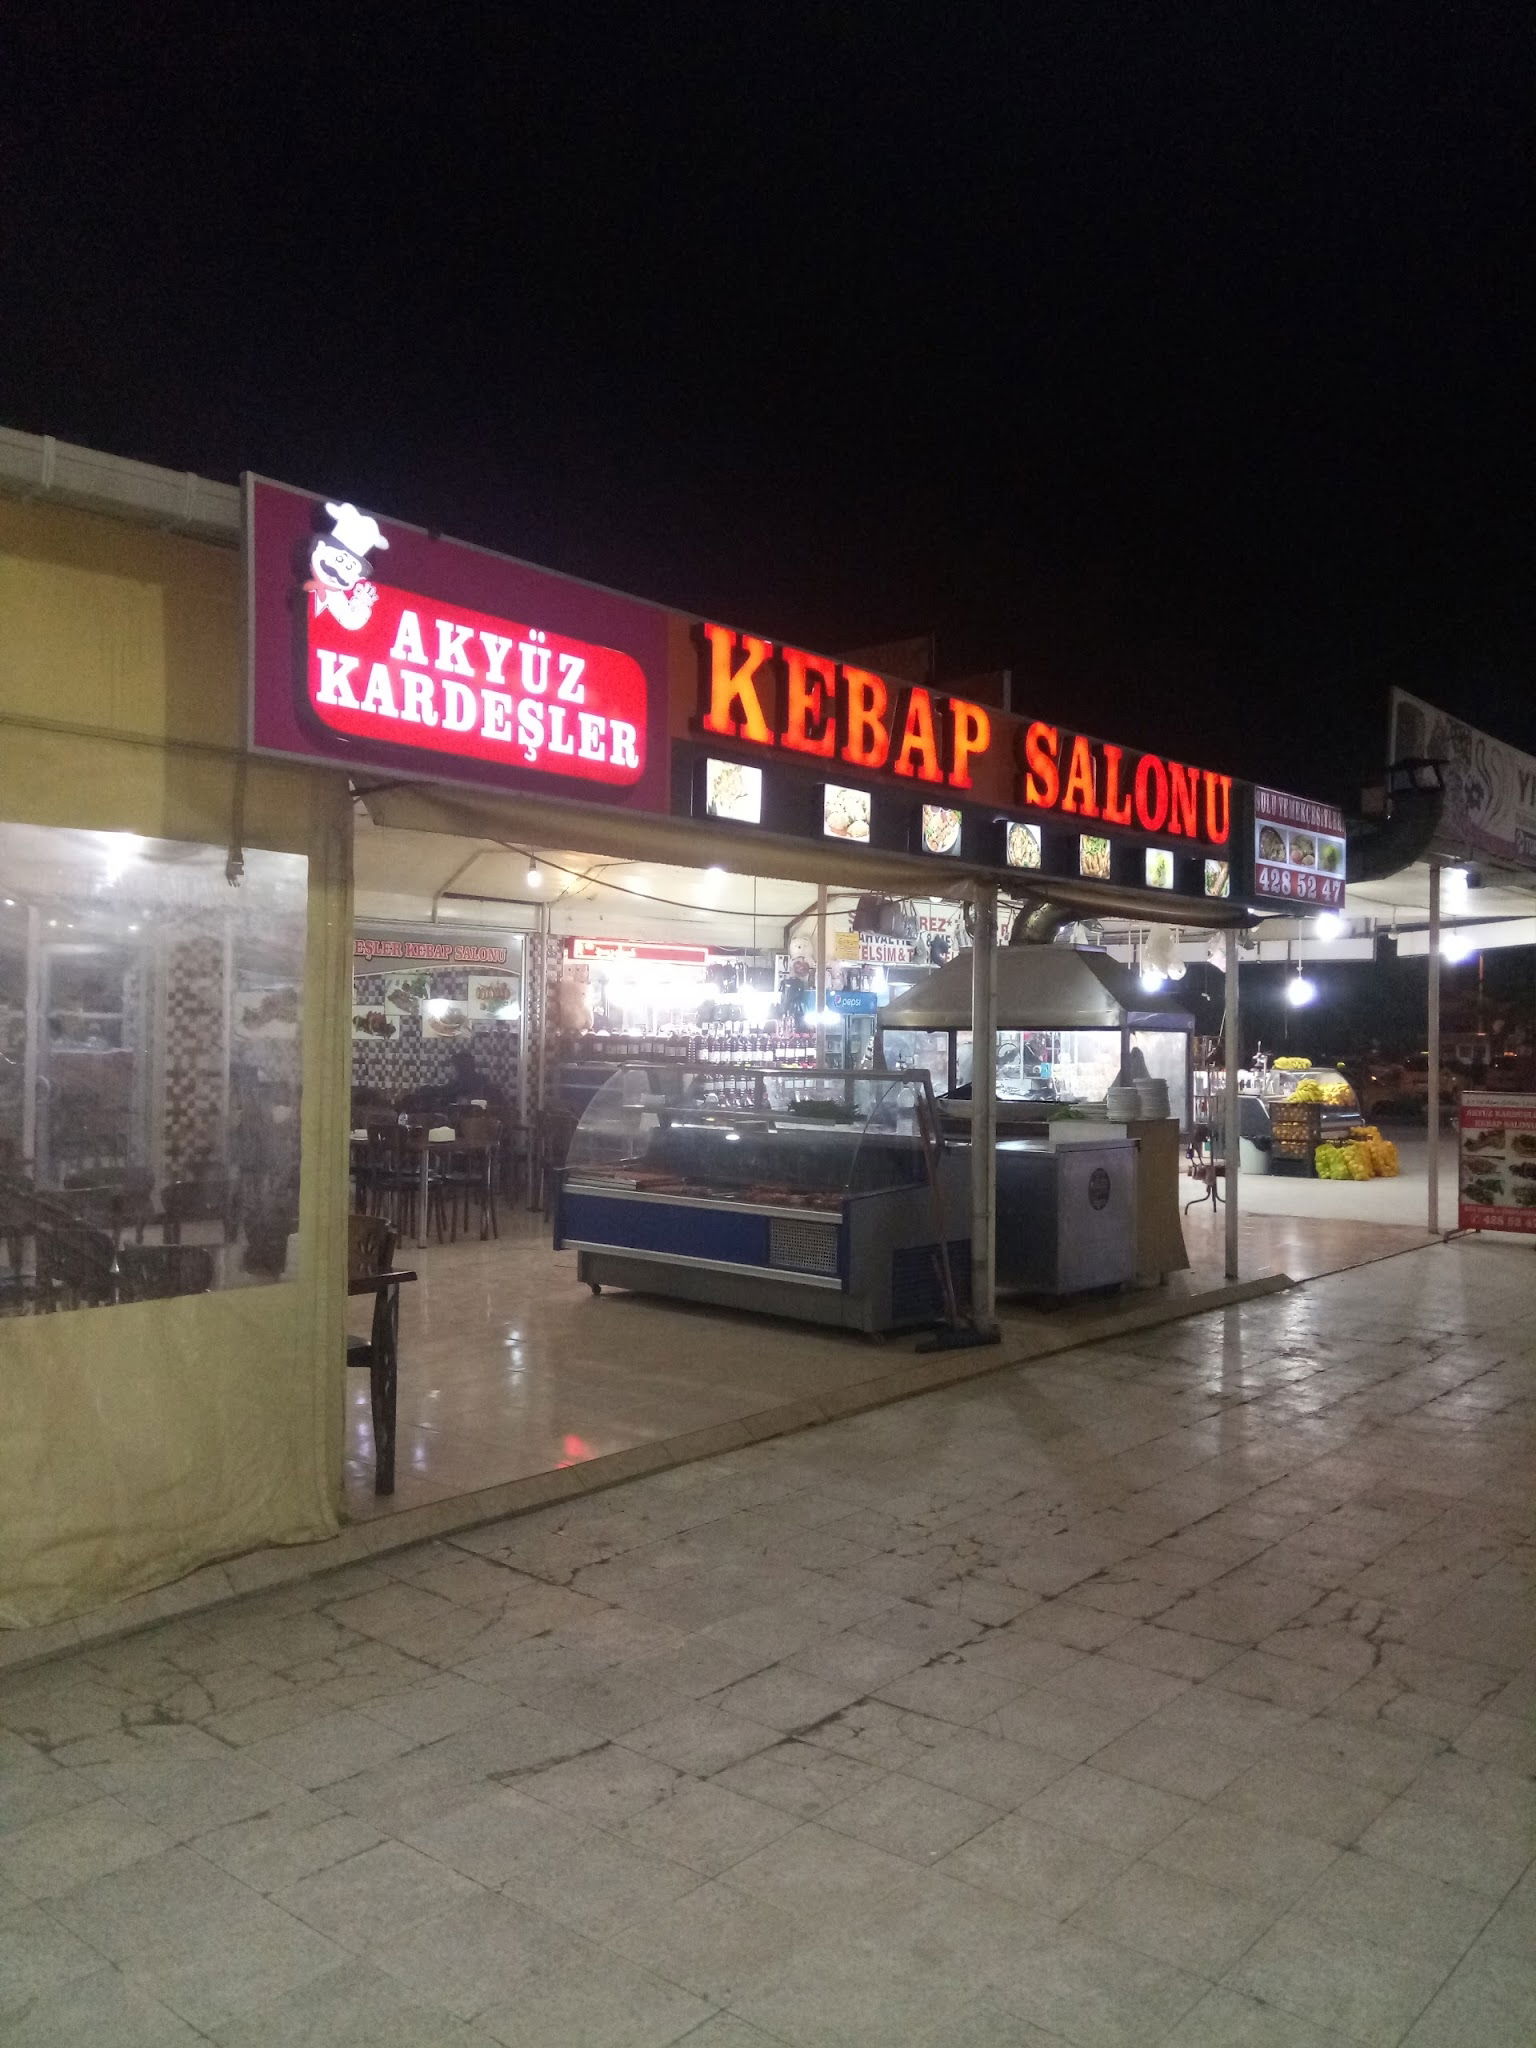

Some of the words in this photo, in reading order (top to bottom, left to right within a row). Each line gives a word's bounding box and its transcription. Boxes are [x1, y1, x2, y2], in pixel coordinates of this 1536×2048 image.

[389, 609, 586, 705] AKYÜZ
[315, 648, 639, 762] KARDEŞLER
[703, 622, 991, 790] KEBAP
[1025, 720, 1232, 845] SALONU
[1259, 867, 1292, 896] 428
[1297, 873, 1317, 899] 52
[1322, 879, 1342, 903] 47
[404, 942, 453, 960] KEBAP
[454, 945, 508, 963] SALONU
[861, 944, 897, 961] ELSİM
[842, 998, 861, 1008] pepsi
